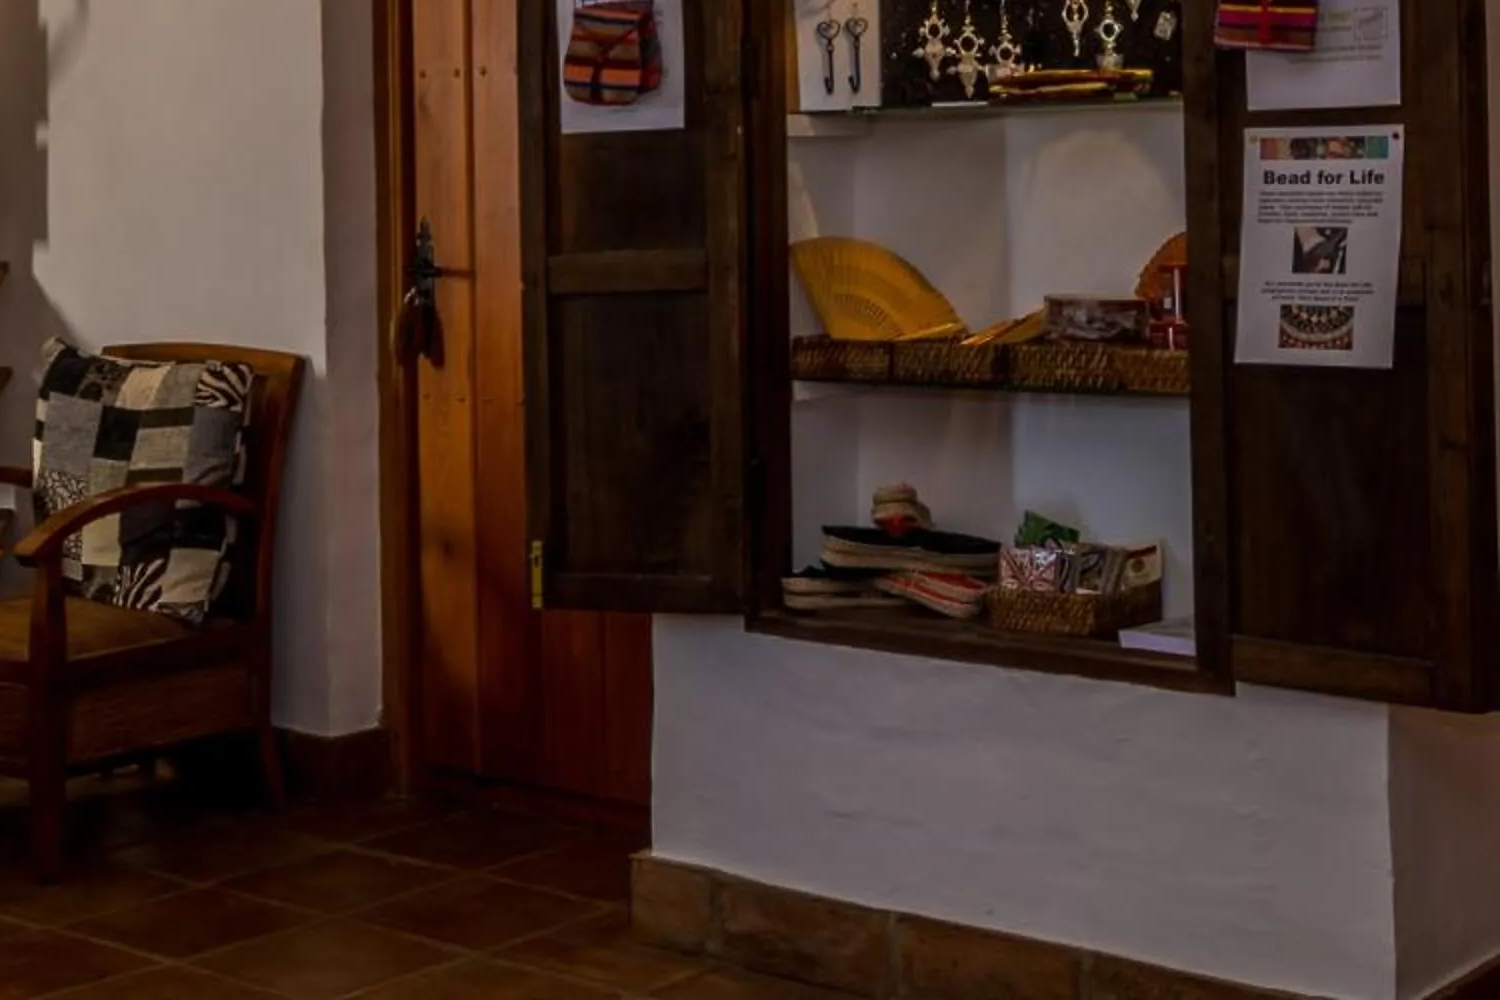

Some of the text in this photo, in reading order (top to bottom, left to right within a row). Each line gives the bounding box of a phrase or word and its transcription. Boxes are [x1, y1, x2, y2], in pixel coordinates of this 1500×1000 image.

[1263, 169, 1385, 185] Bead for Life
